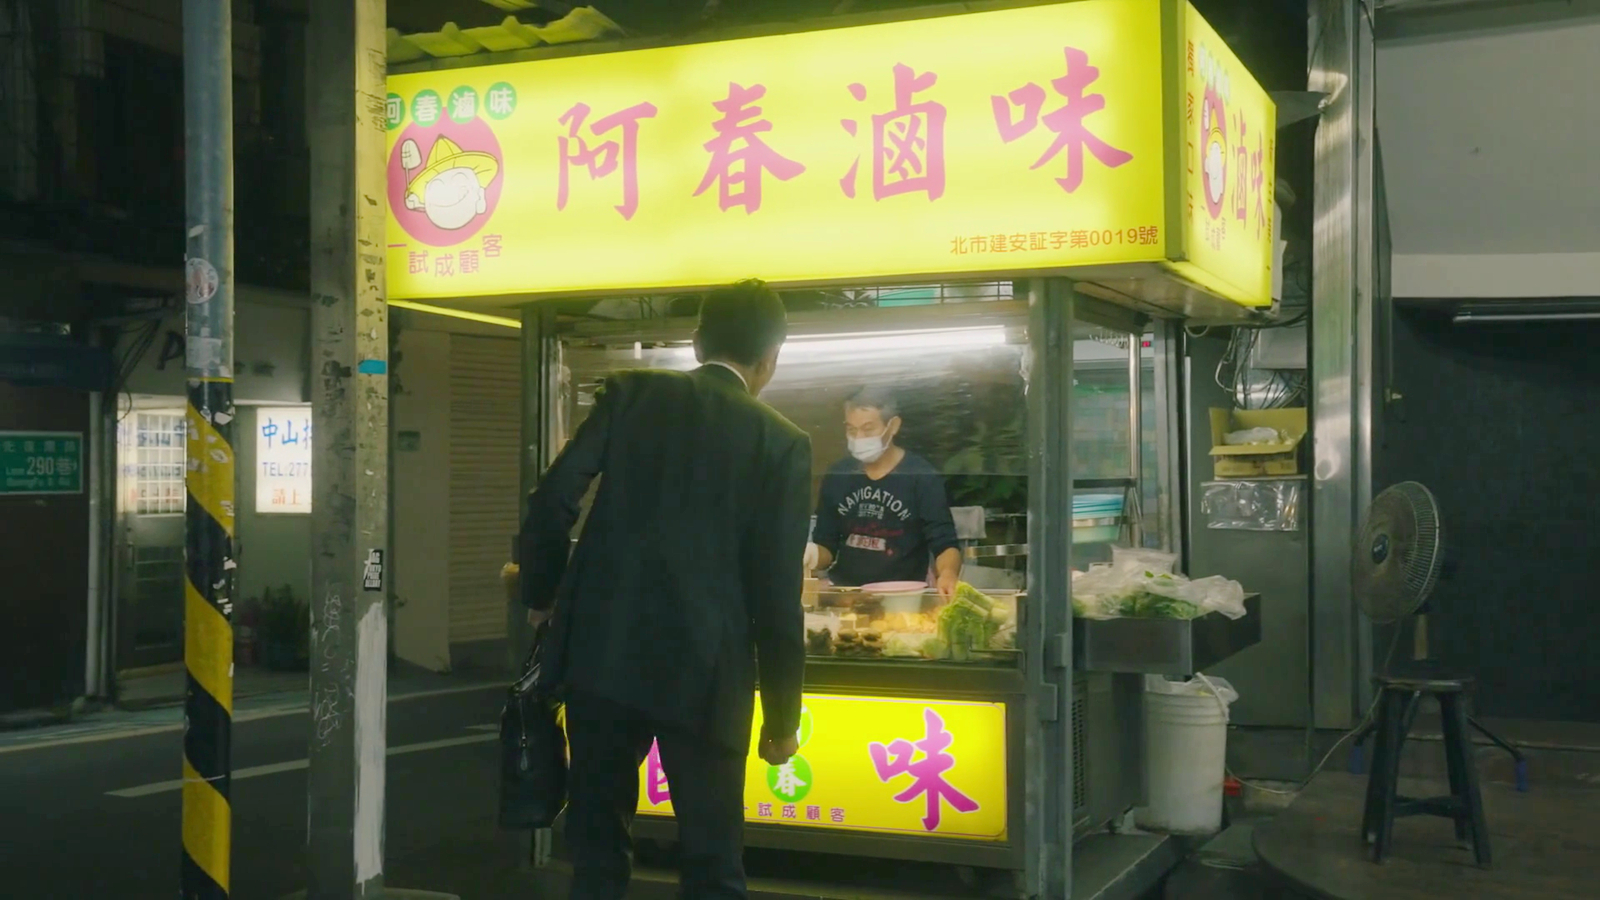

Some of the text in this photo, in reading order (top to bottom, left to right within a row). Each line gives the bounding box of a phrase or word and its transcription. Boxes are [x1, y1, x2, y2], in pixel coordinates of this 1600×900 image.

[557, 46, 1133, 221] 阿春滷味
[1231, 107, 1265, 241] 滷味
[387, 234, 503, 278] 一試成顧客
[950, 226, 1159, 256] 北市建安証字第0019號
[838, 486, 911, 521] NAVIGATION
